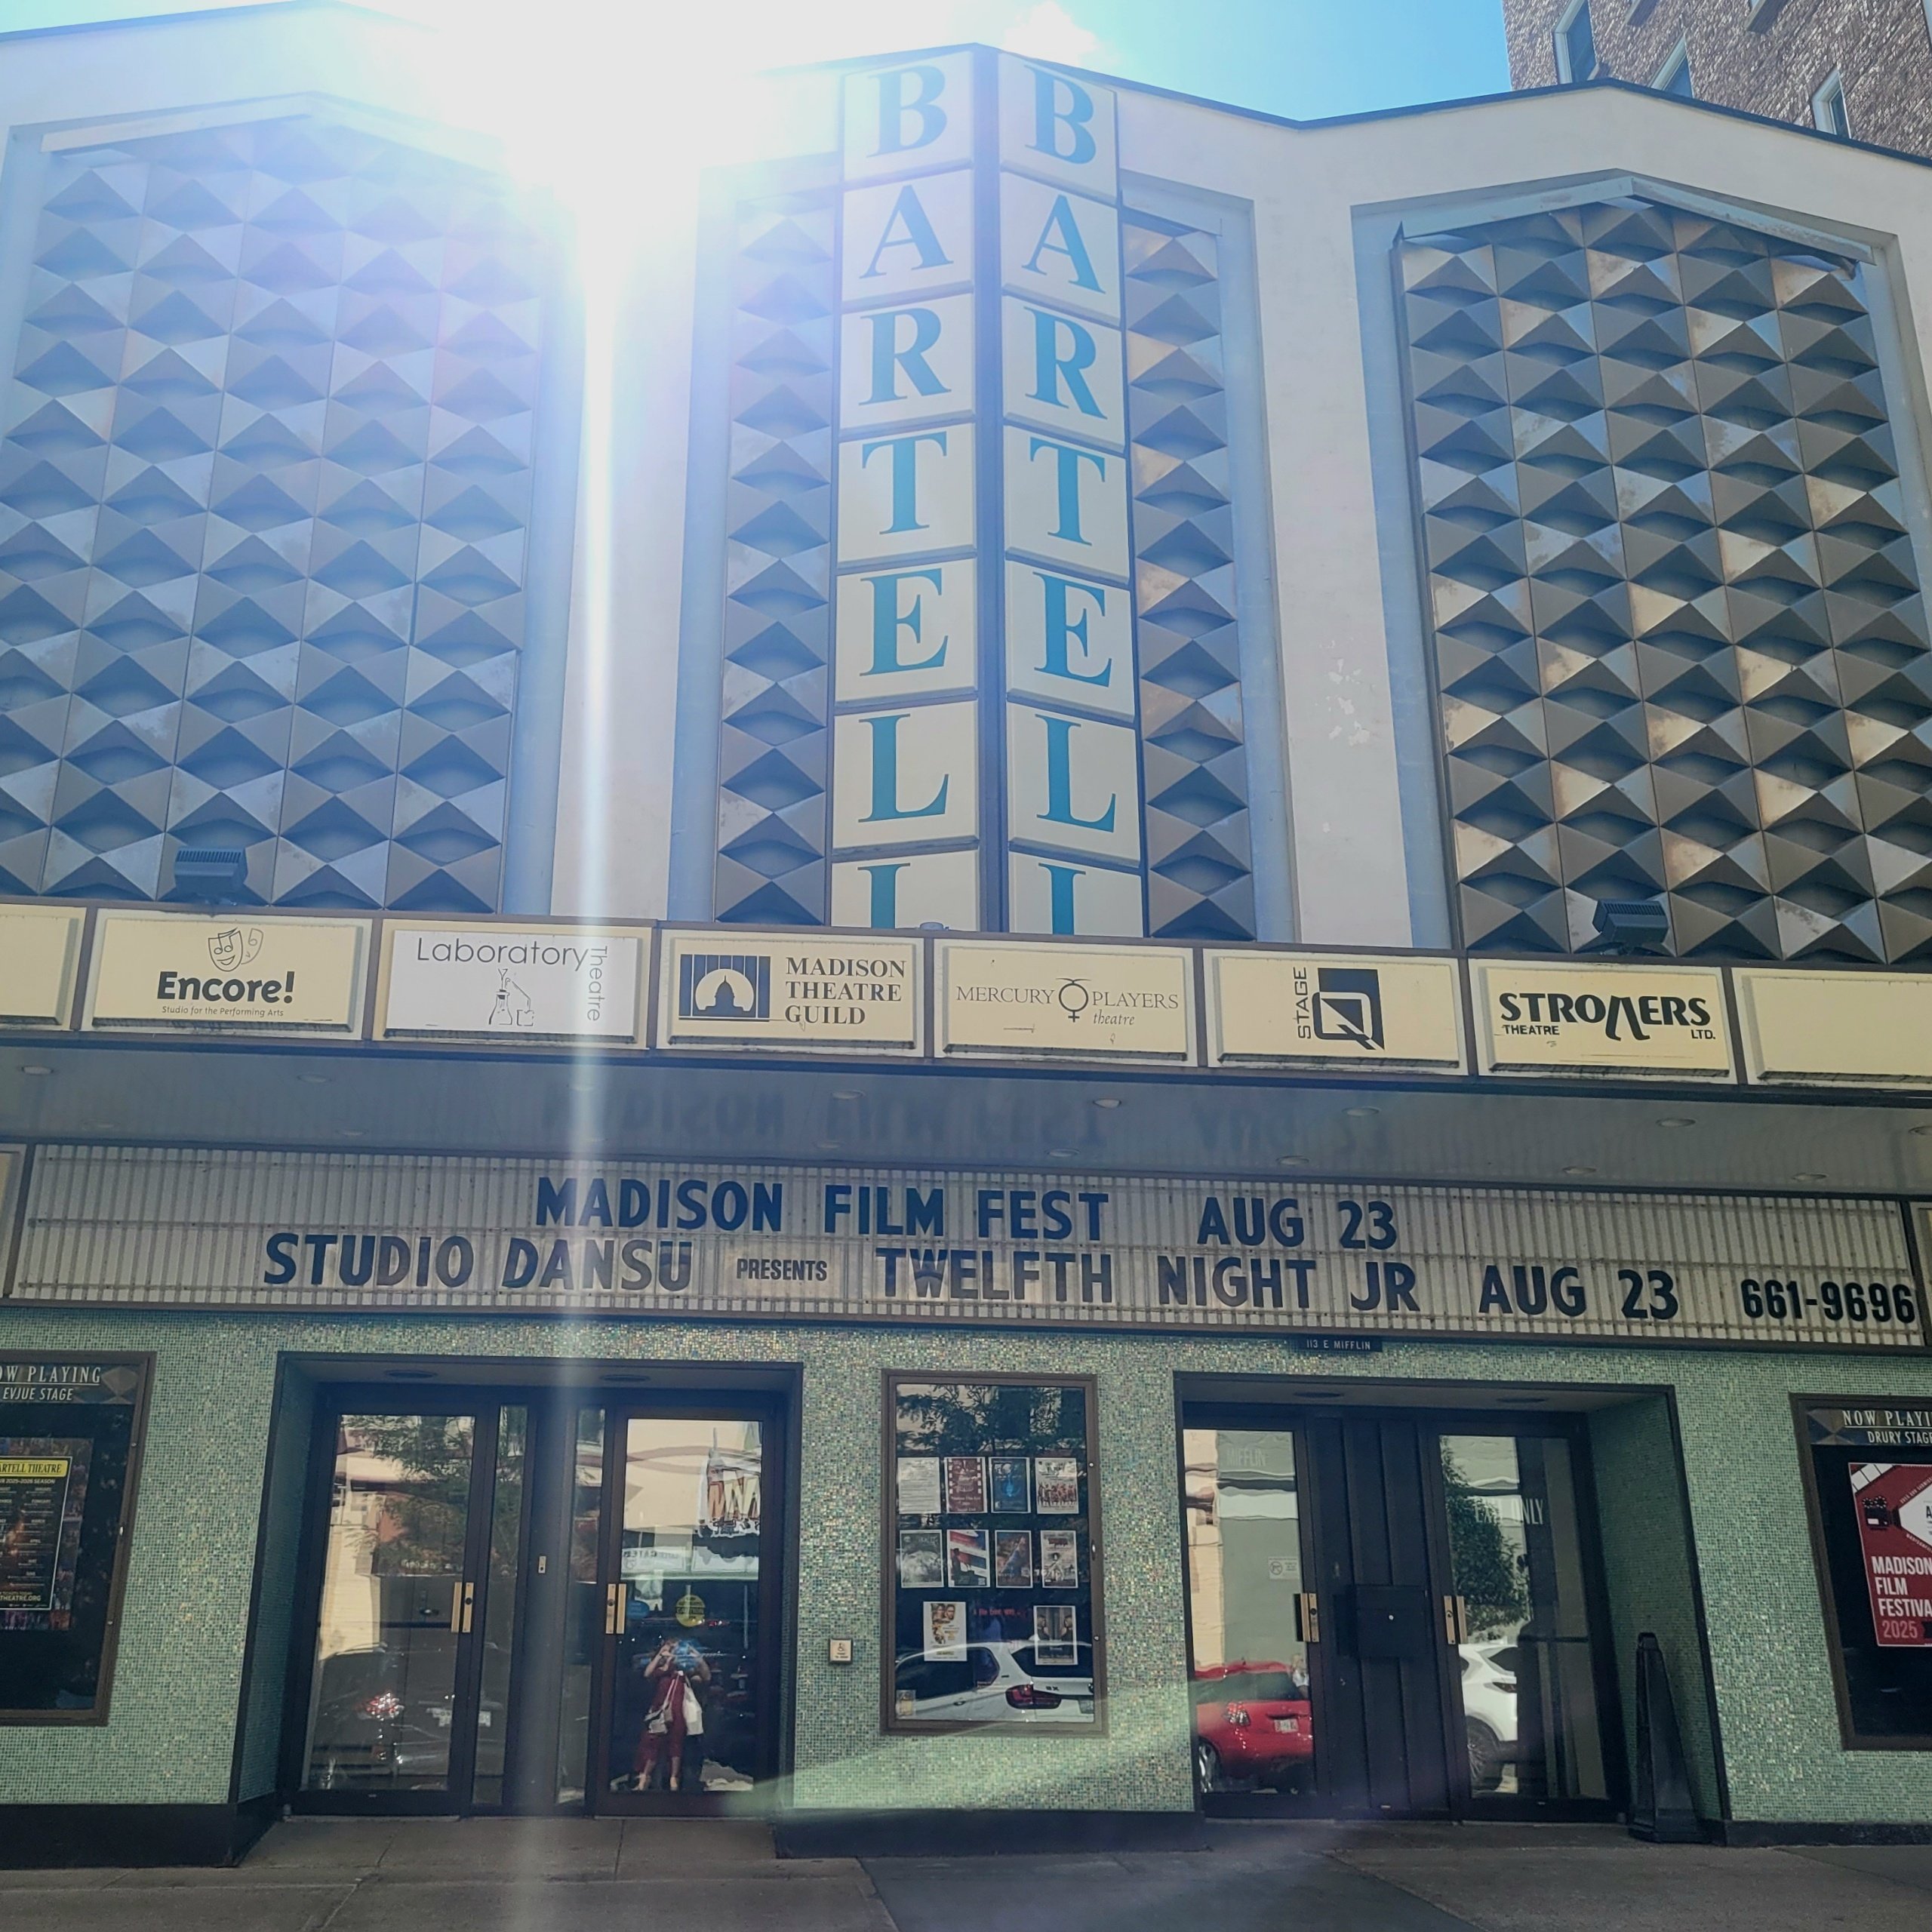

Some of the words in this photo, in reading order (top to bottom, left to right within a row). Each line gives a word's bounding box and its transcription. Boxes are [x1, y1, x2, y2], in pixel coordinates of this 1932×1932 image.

[417, 937, 589, 971] Laboratory
[785, 956, 906, 979] MADISON
[157, 971, 295, 1004] Encore!
[587, 946, 608, 1021] Theatre
[786, 981, 903, 1003] THEATRE
[956, 986, 1055, 1004] MERCURY
[1093, 991, 1179, 1008] PLAYERS
[1293, 967, 1312, 1039] STAGE
[162, 1006, 189, 1014] Studio
[190, 1006, 203, 1016] for
[205, 1007, 217, 1015] the
[220, 1008, 265, 1017] Performing
[784, 1005, 866, 1025] GUILD
[1093, 1009, 1135, 1026] theatre
[1502, 1025, 1560, 1035] THEATRE
[1690, 1029, 1716, 1040] LTD.
[536, 1177, 783, 1232] MADISON
[825, 1185, 944, 1236] FILM
[977, 1190, 1109, 1241] FEST
[1197, 1197, 1305, 1247] AUG
[1338, 1201, 1397, 1251] 23
[264, 1232, 475, 1287] STUDIO
[737, 1257, 828, 1281] PRESENTS
[875, 1247, 1112, 1303] TWELFTH
[1158, 1255, 1316, 1309] NIGHT
[1350, 1260, 1420, 1312] JR
[1478, 1264, 1586, 1317] AUG
[1617, 1269, 1679, 1320] 23
[1740, 1278, 1916, 1324] 661-9696
[1306, 1340, 1318, 1348] 113
[1324, 1340, 1329, 1349] E
[1334, 1340, 1371, 1350] MIFFLIN
[27, 1365, 100, 1383] PLAYING
[3, 1387, 35, 1400] EVJUE
[39, 1388, 73, 1401] STAGE
[1842, 1410, 1875, 1426] NOW
[1884, 1411, 1932, 1426] PLAYI
[1867, 1431, 1900, 1444] DRURY
[1226, 1447, 1266, 1467] MIFFLIN
[0, 1463, 26, 1473] RTELL
[28, 1463, 62, 1474] THEATRE
[1872, 1556, 1932, 1575] MADISON
[1875, 1577, 1909, 1595] FILM
[1881, 1620, 1918, 1638] 2025
